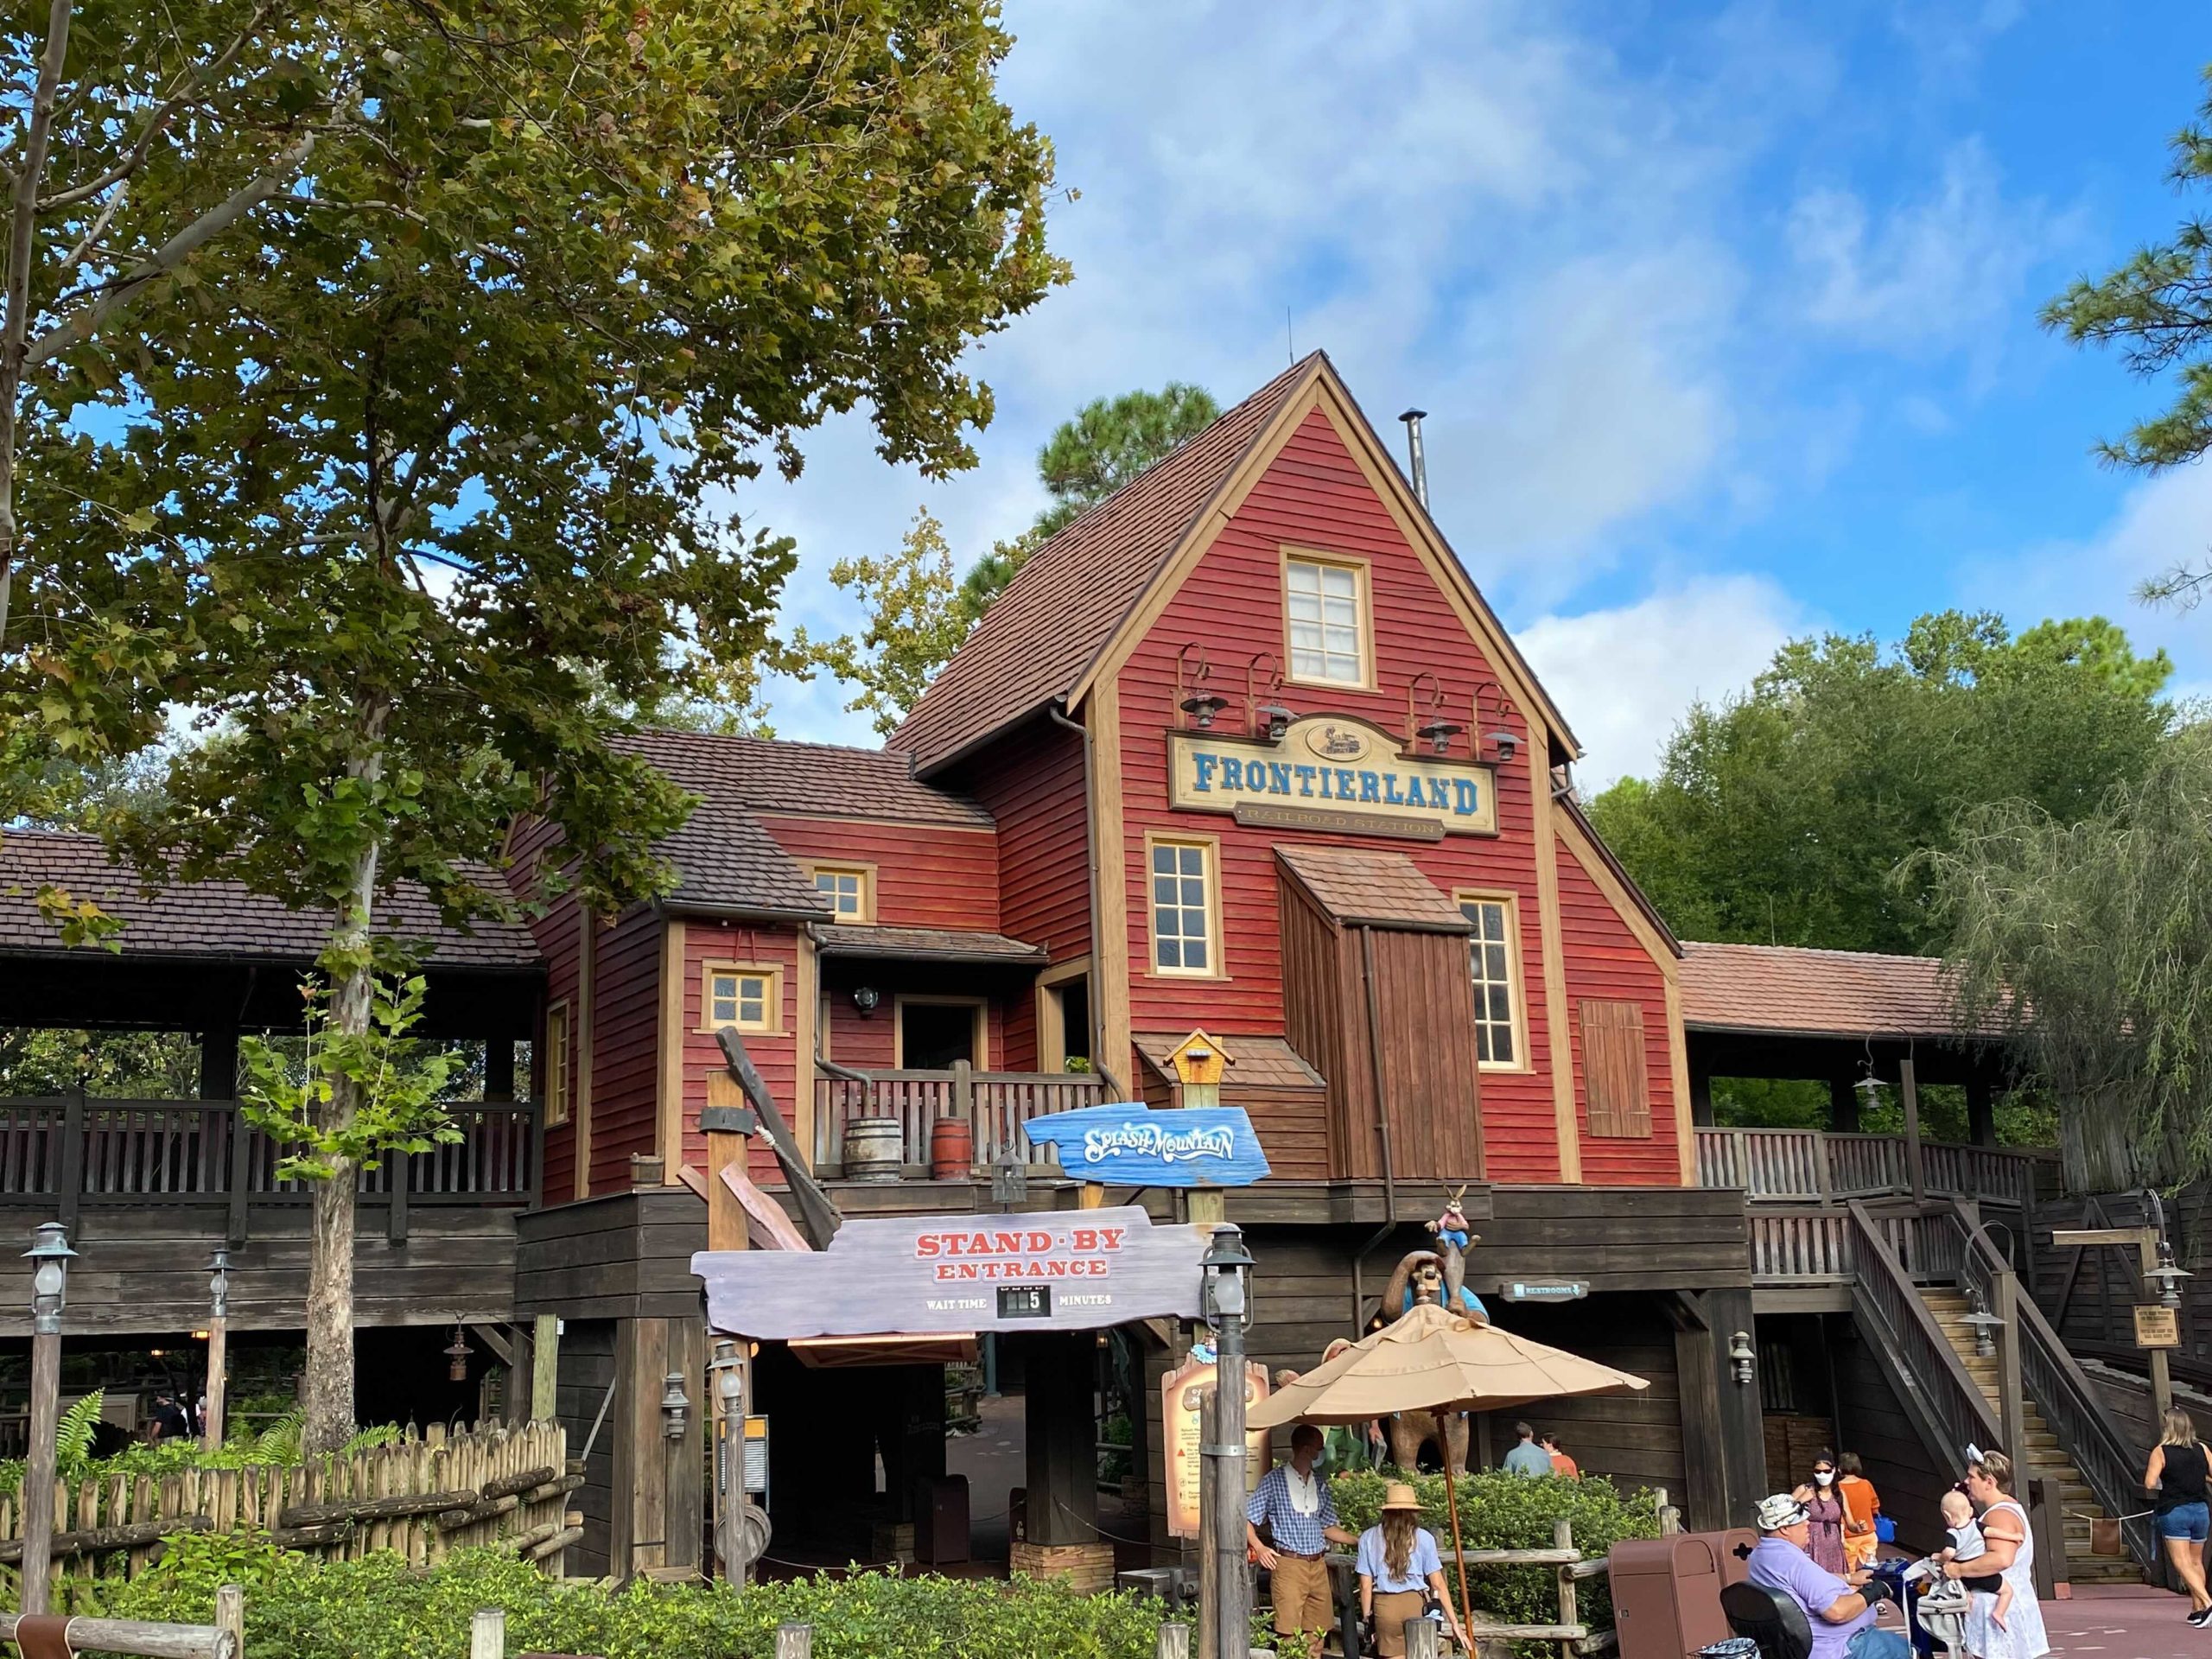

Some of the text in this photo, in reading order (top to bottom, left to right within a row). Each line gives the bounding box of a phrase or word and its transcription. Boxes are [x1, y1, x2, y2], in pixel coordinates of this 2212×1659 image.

[1192, 752, 1478, 816] FRONTIERLAND
[1246, 809, 1436, 834] RAILROAD STATION
[936, 1259, 1108, 1280] ENTRANCE
[925, 1291, 1112, 1311] WAIT TIME 5 MINUTES
